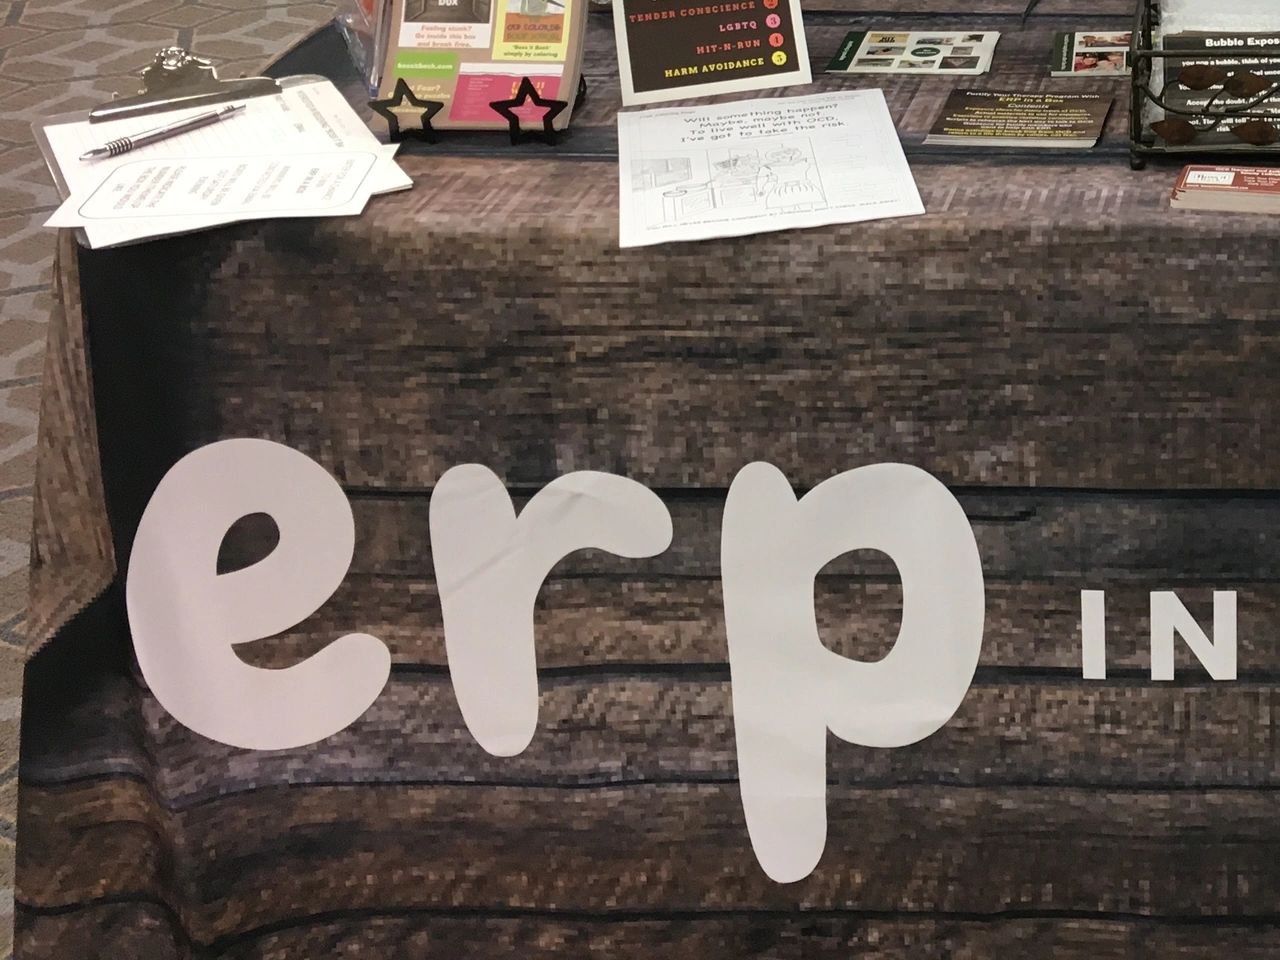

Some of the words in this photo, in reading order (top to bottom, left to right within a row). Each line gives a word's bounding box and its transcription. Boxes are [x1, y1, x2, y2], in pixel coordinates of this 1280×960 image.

[629, 10, 676, 23] TENDER
[680, 1, 756, 17] CONSCIENCE
[719, 21, 758, 33] LGBTQ
[696, 39, 761, 55] HIT-N-RUN
[1205, 38, 1244, 48] Bubble
[664, 66, 699, 78] HARM
[701, 57, 764, 73] AVOIDANCE
[683, 116, 711, 124] Will
[715, 109, 782, 121] something
[786, 103, 839, 114] happen?
[752, 114, 796, 123] maybe
[710, 132, 732, 141] got
[759, 127, 788, 135] take
[126, 438, 985, 884] erp
[1080, 589, 1238, 681] IN
